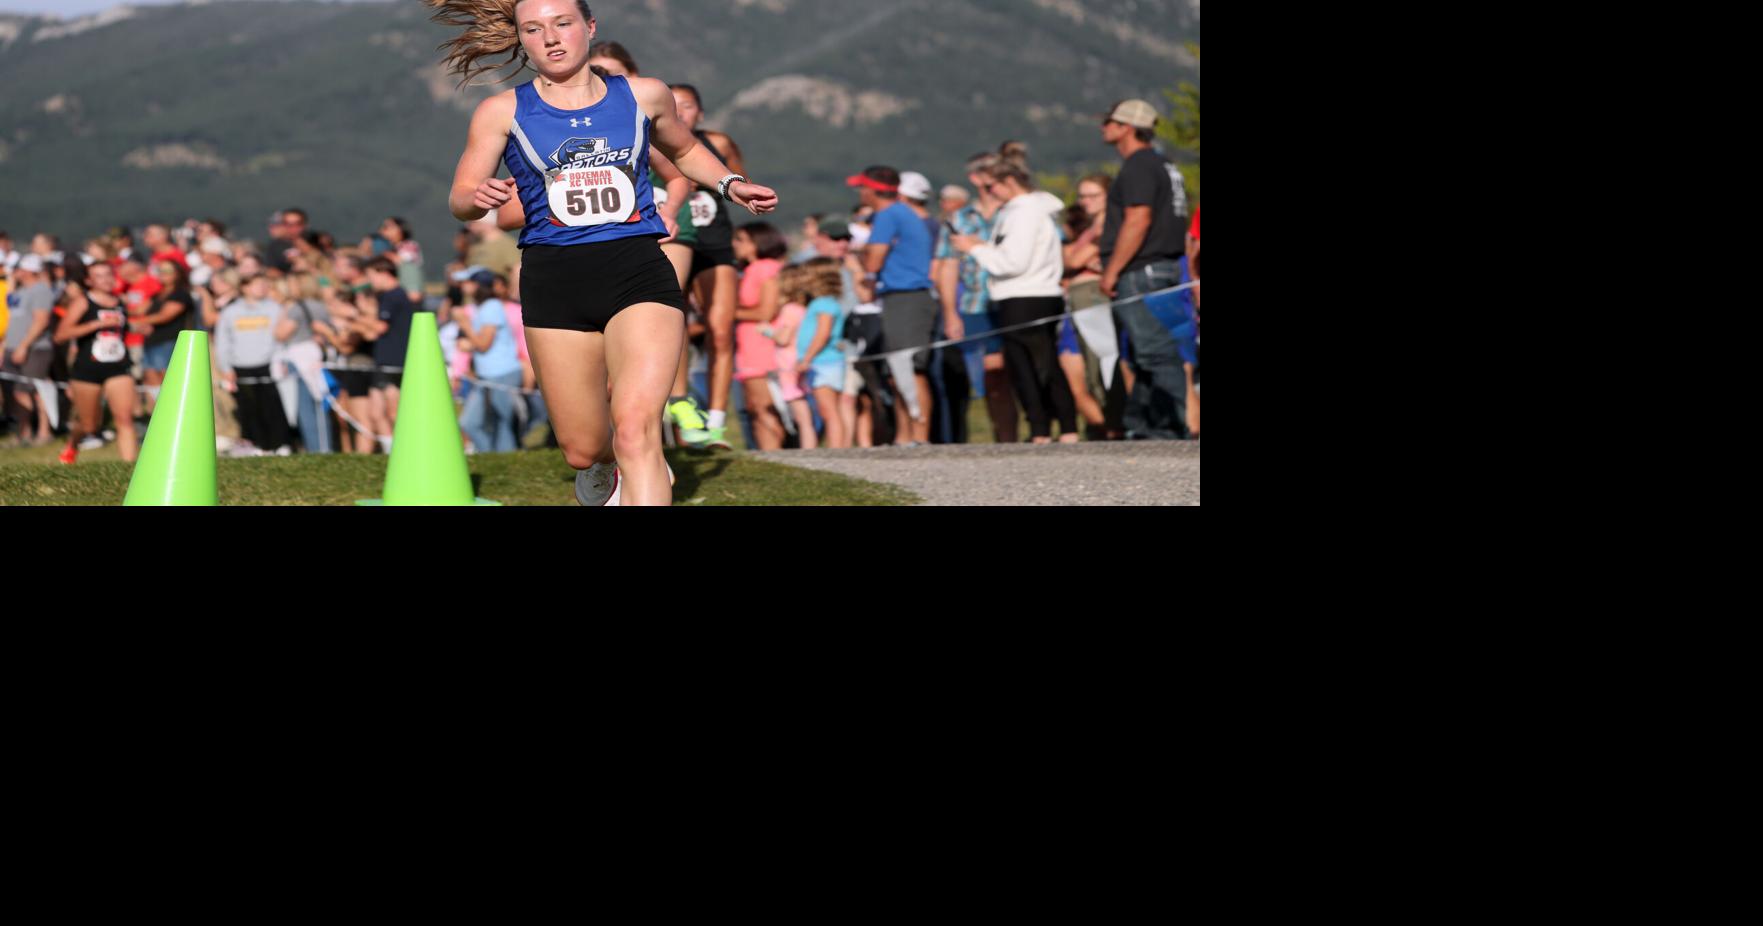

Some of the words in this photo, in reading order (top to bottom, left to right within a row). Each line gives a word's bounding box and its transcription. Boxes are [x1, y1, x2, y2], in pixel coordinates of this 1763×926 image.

[569, 170, 612, 180] BOZEMAN
[570, 180, 581, 188] XC
[585, 177, 613, 186] INVITE
[565, 187, 621, 216] 510
